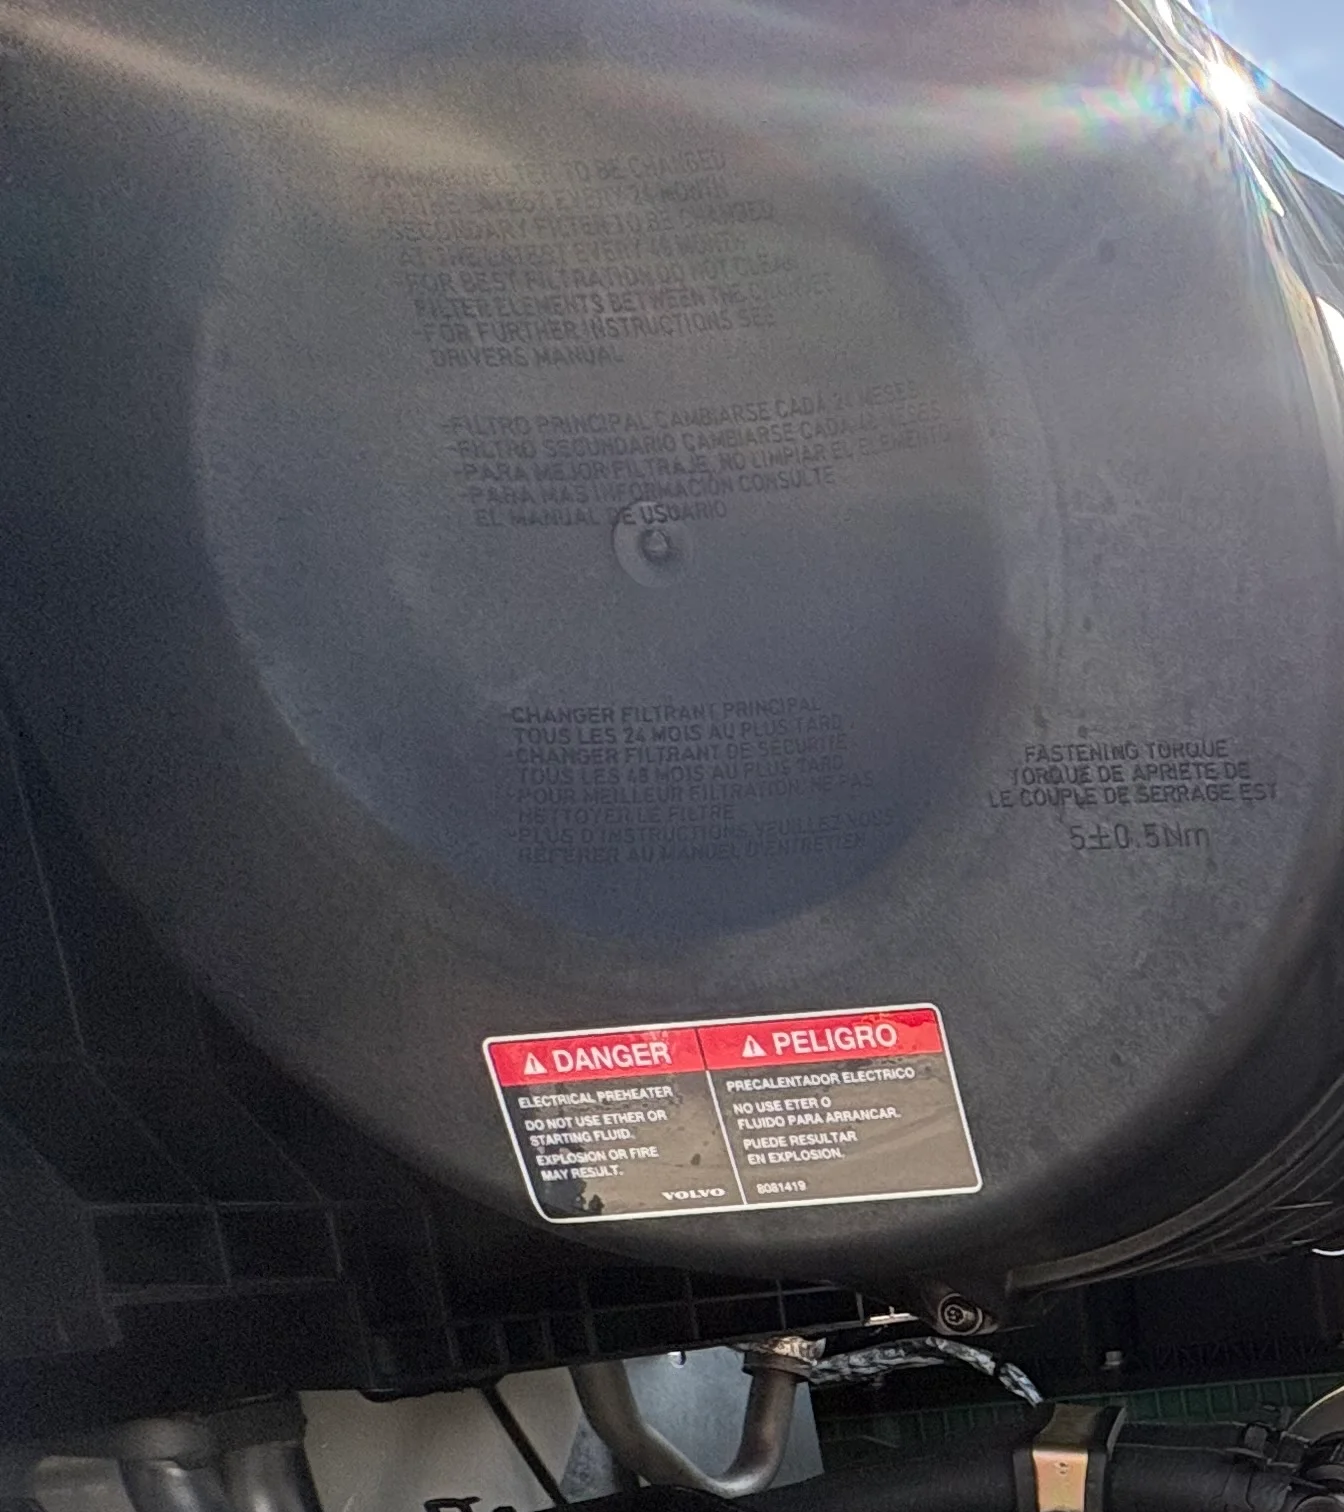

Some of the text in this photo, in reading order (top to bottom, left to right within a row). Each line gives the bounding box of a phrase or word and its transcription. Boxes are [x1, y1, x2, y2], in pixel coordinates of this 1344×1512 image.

[620, 702, 720, 723] FILTRANT
[723, 697, 822, 717] PRINCIPAL
[514, 726, 571, 744] TOUS
[579, 726, 617, 744] LES
[651, 723, 700, 742] MOIS
[709, 722, 734, 740] AU
[741, 718, 788, 737] PLUS
[624, 743, 722, 763] FILTRANT
[726, 742, 753, 760] DE
[1024, 738, 1230, 763] FASTENING TORQUE
[521, 768, 573, 785] TOUS
[581, 767, 620, 785] LES
[1011, 760, 1252, 787] TORQUE DE APRIETE DE
[989, 782, 1278, 809] LE COUPLE DE SERRAGE EST
[771, 1023, 899, 1056] PELIGRO
[552, 1041, 673, 1074] DANGER
[726, 1067, 916, 1093] PRECALENTADOR ELECTRICO
[518, 1086, 674, 1109] ELECTRICAL PREHEATER
[732, 1096, 832, 1115] NO USE ETER O
[525, 1109, 668, 1131] DO NOT USE ETHER OR
[737, 1106, 902, 1131] FLUIDO PARA ARRANCAR.
[529, 1128, 637, 1147] STARTING FLUID.
[743, 1130, 858, 1151] PUEDE RESULTAR
[536, 1146, 660, 1167] EXPLOSION OR FIRE
[747, 1147, 846, 1166] EN EXPLOSION.
[541, 1164, 625, 1181] MAY RESULT.
[661, 1187, 727, 1201] VOLVO
